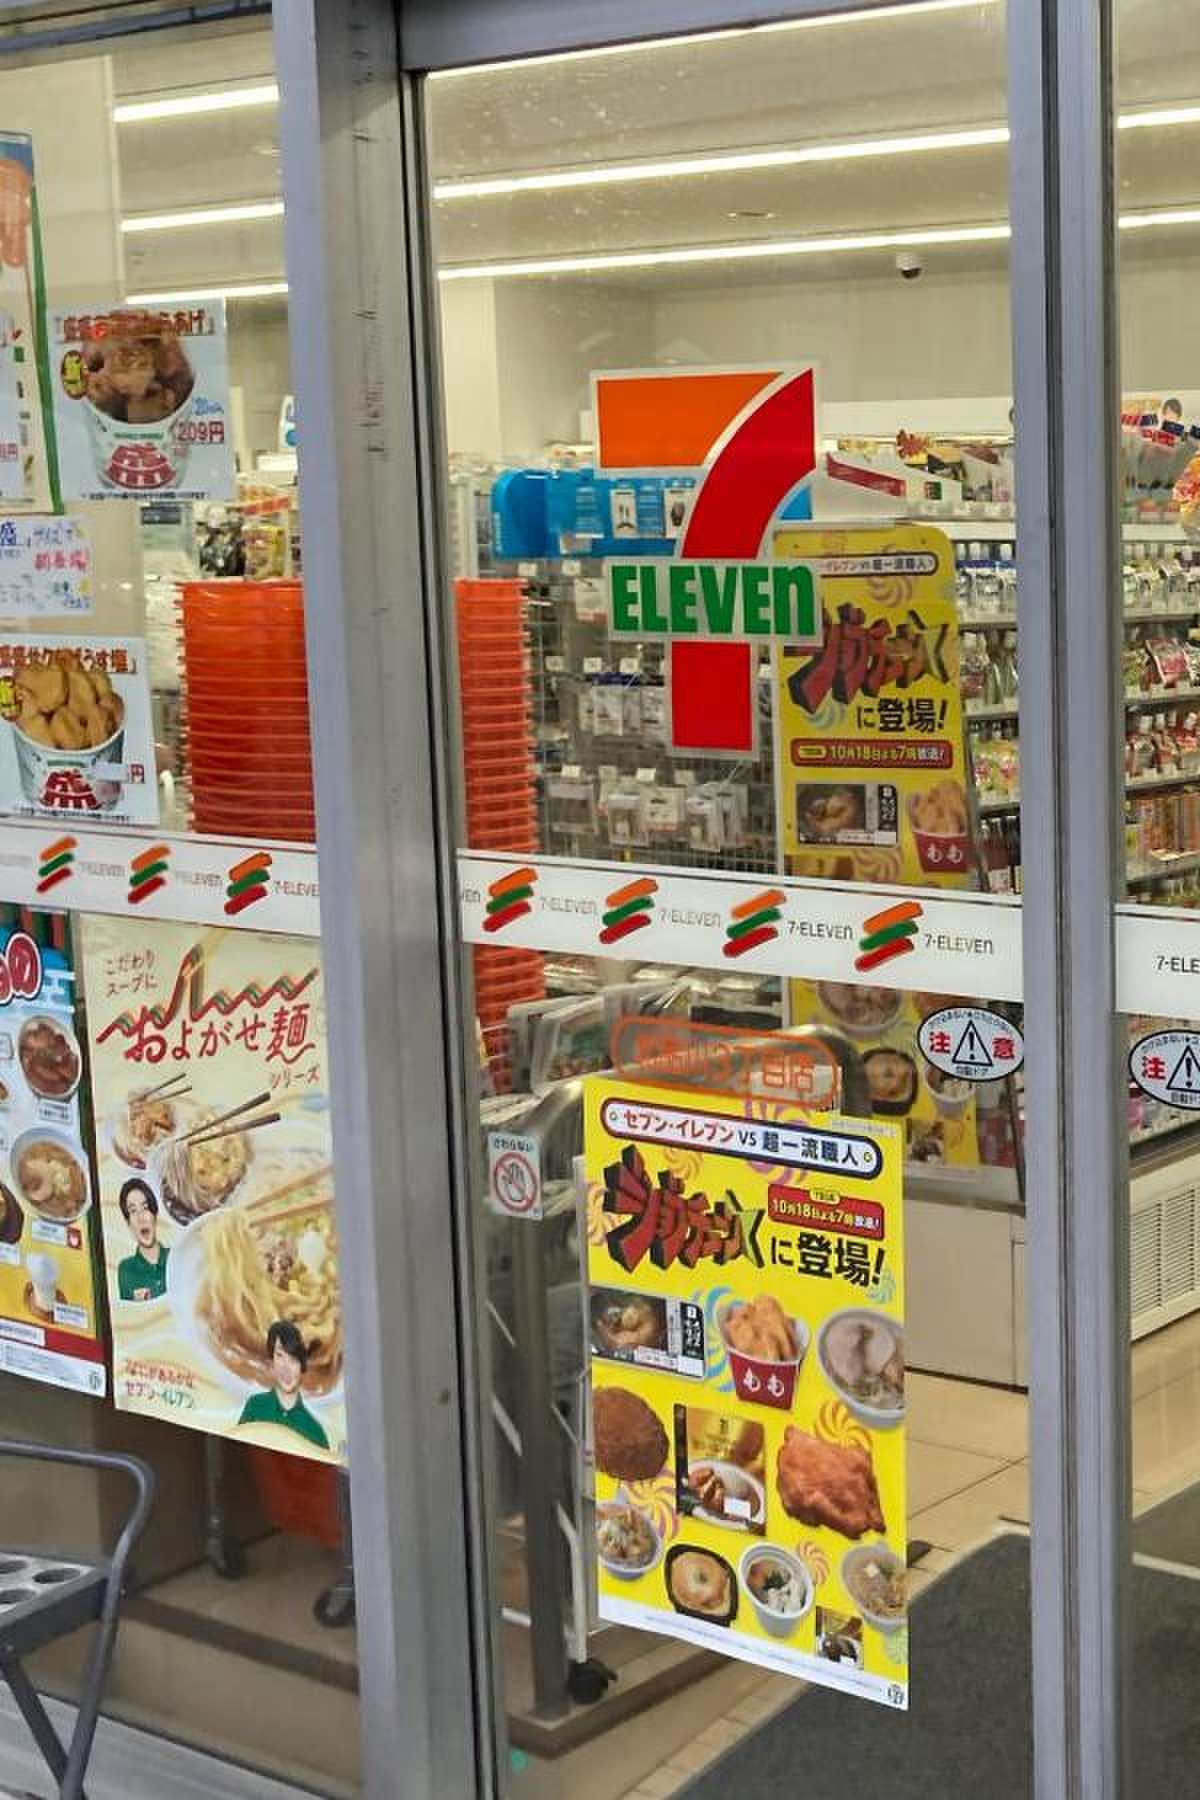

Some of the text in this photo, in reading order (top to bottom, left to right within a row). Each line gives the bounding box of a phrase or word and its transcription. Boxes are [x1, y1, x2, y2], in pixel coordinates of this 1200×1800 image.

[274, 881, 319, 897] 7-ELEVE
[124, 1004, 317, 1065] およがせ麺
[270, 1066, 320, 1089] シリーズ
[738, 1129, 757, 1148] VS
[762, 1130, 860, 1167] 超一流職人
[770, 1230, 886, 1288] に登場!
[742, 1366, 786, 1398] もも
